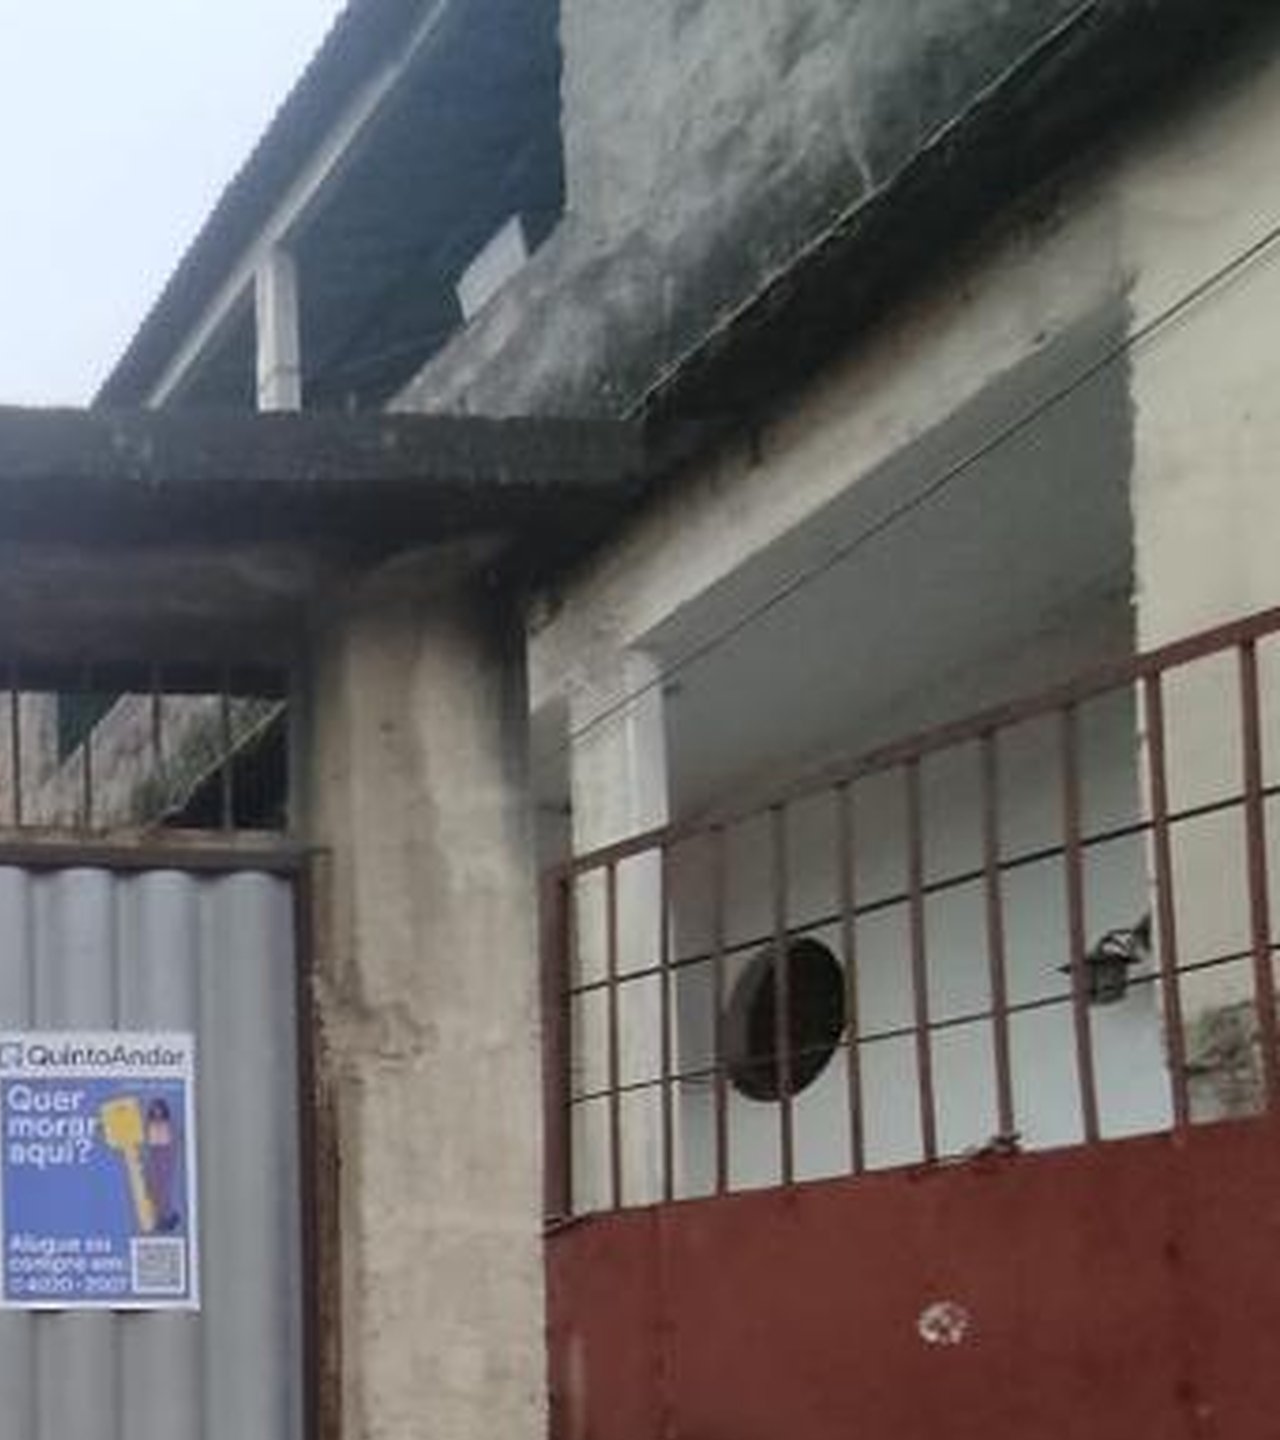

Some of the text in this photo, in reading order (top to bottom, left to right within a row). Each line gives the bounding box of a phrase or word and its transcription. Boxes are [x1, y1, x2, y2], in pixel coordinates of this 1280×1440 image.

[27, 1045, 185, 1066] QuintoAndar
[7, 1084, 86, 1112] Quer
[7, 1116, 96, 1138] morar
[9, 1138, 94, 1169] aqui?
